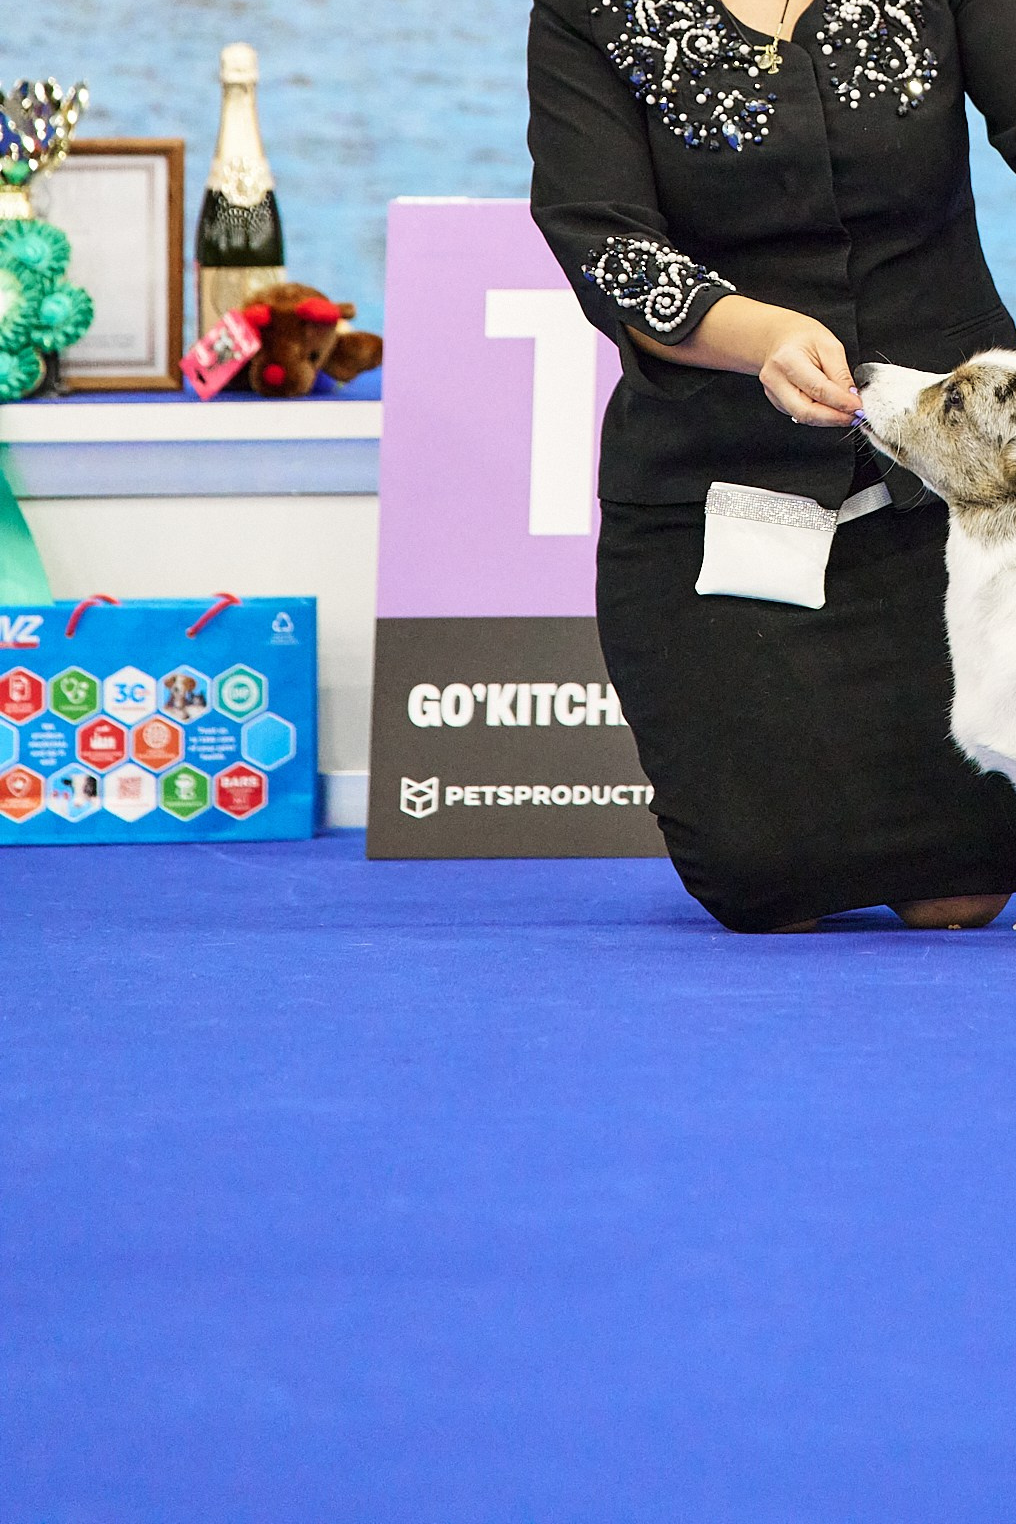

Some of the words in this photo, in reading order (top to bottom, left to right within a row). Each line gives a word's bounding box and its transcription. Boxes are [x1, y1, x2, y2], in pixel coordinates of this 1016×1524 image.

[484, 288, 598, 536] 1
[0, 614, 44, 643] VZ
[407, 682, 629, 727] GO'KITCH
